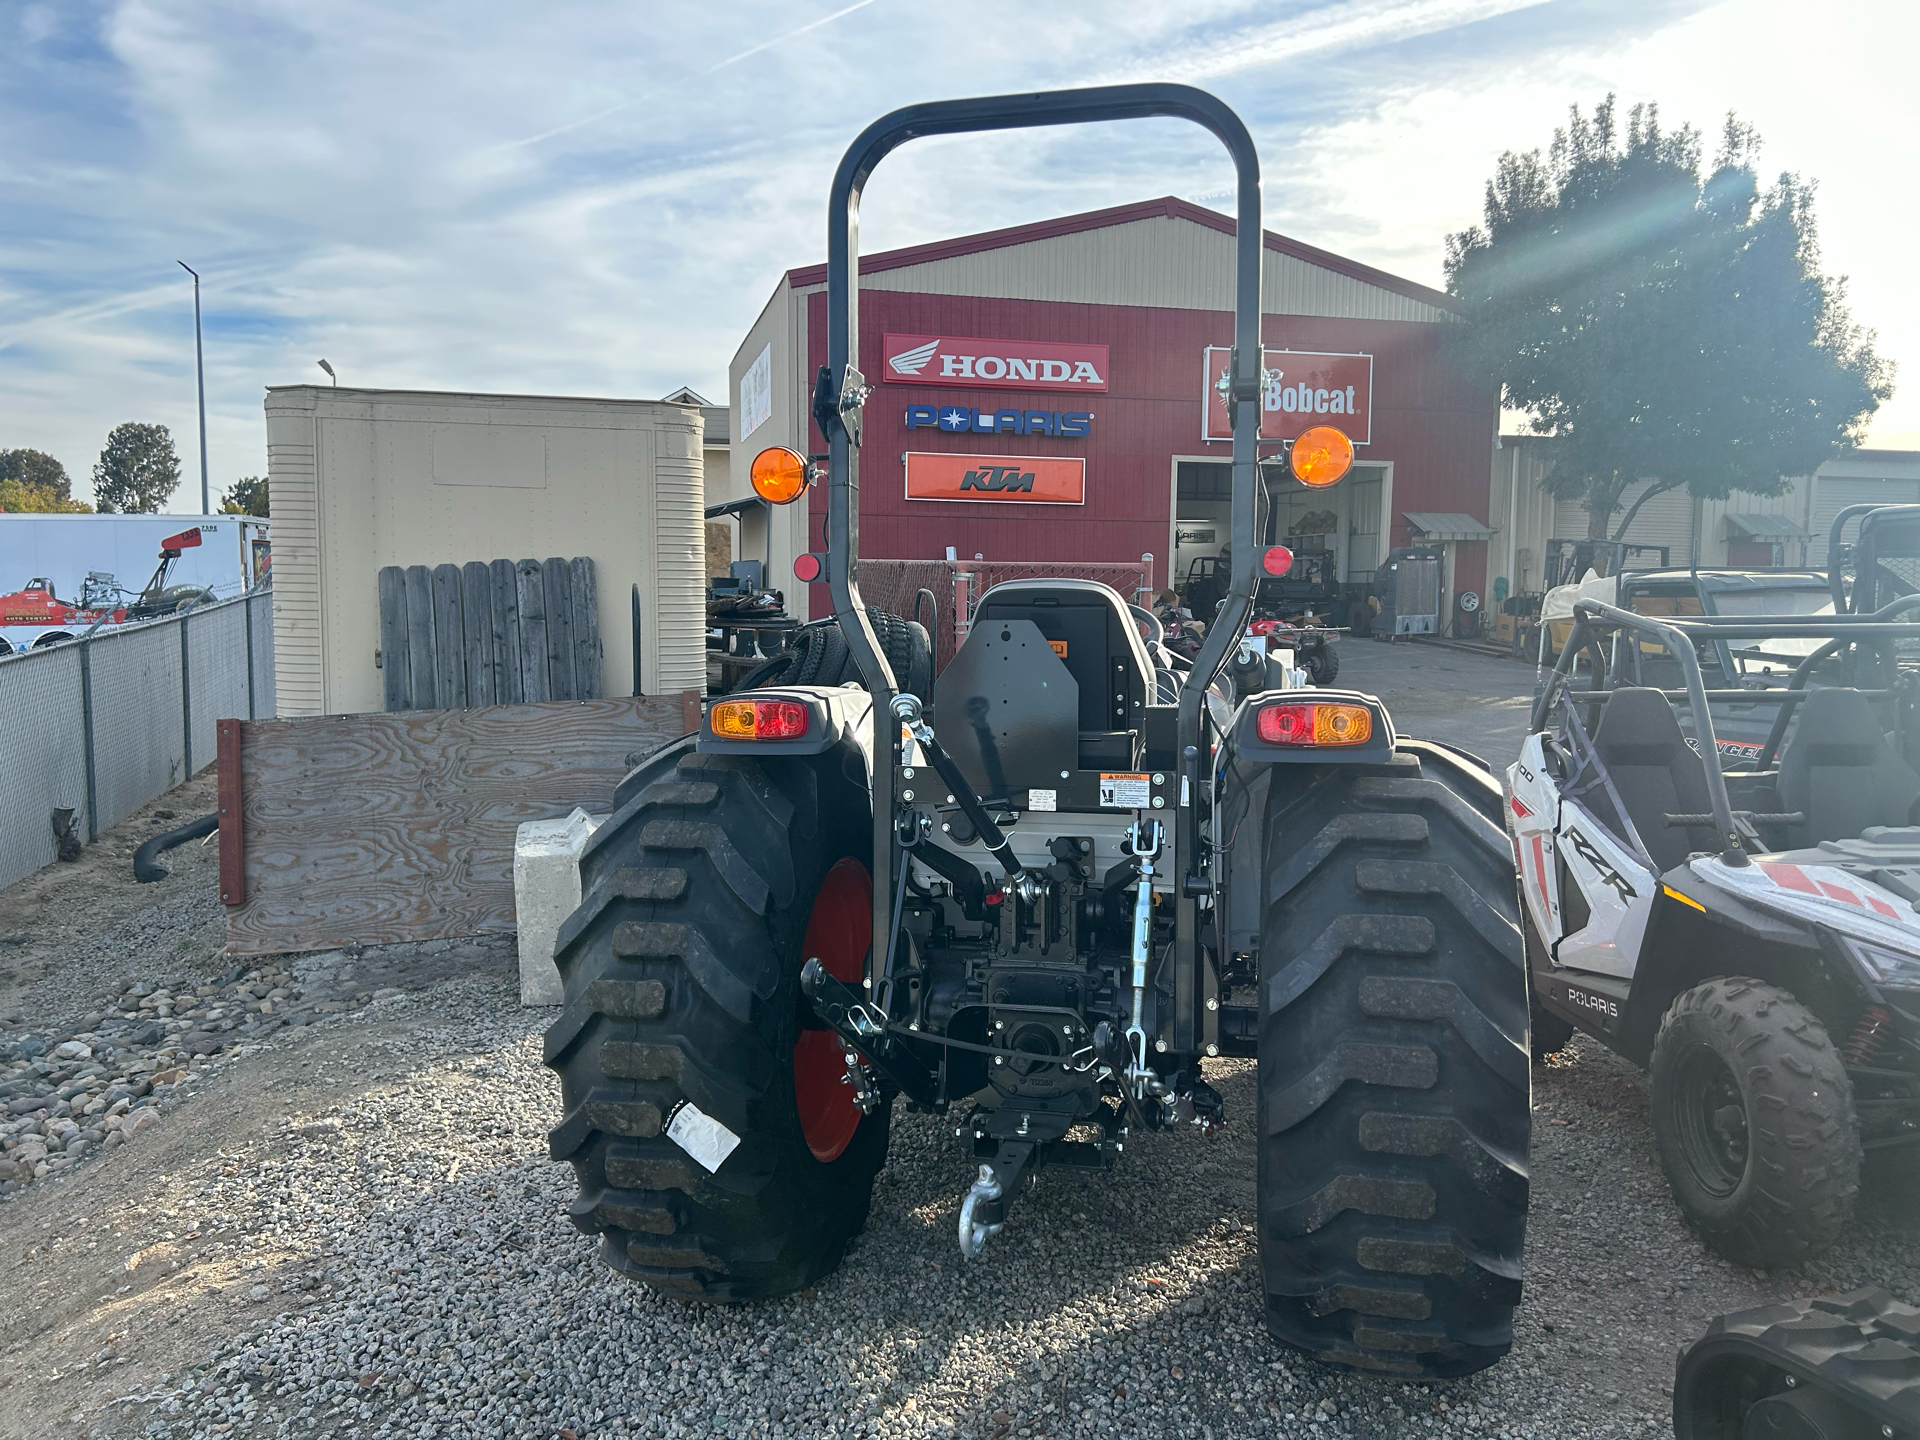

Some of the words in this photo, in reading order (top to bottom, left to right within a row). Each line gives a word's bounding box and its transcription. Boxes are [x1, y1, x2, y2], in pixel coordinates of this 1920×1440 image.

[940, 354, 1104, 384] HONDA
[1265, 380, 1355, 415] Bobcat
[907, 404, 1091, 437] POLARIS
[959, 466, 1035, 492] KTM
[1561, 825, 1639, 908] RZR
[1568, 988, 1618, 1018] POLARIS
